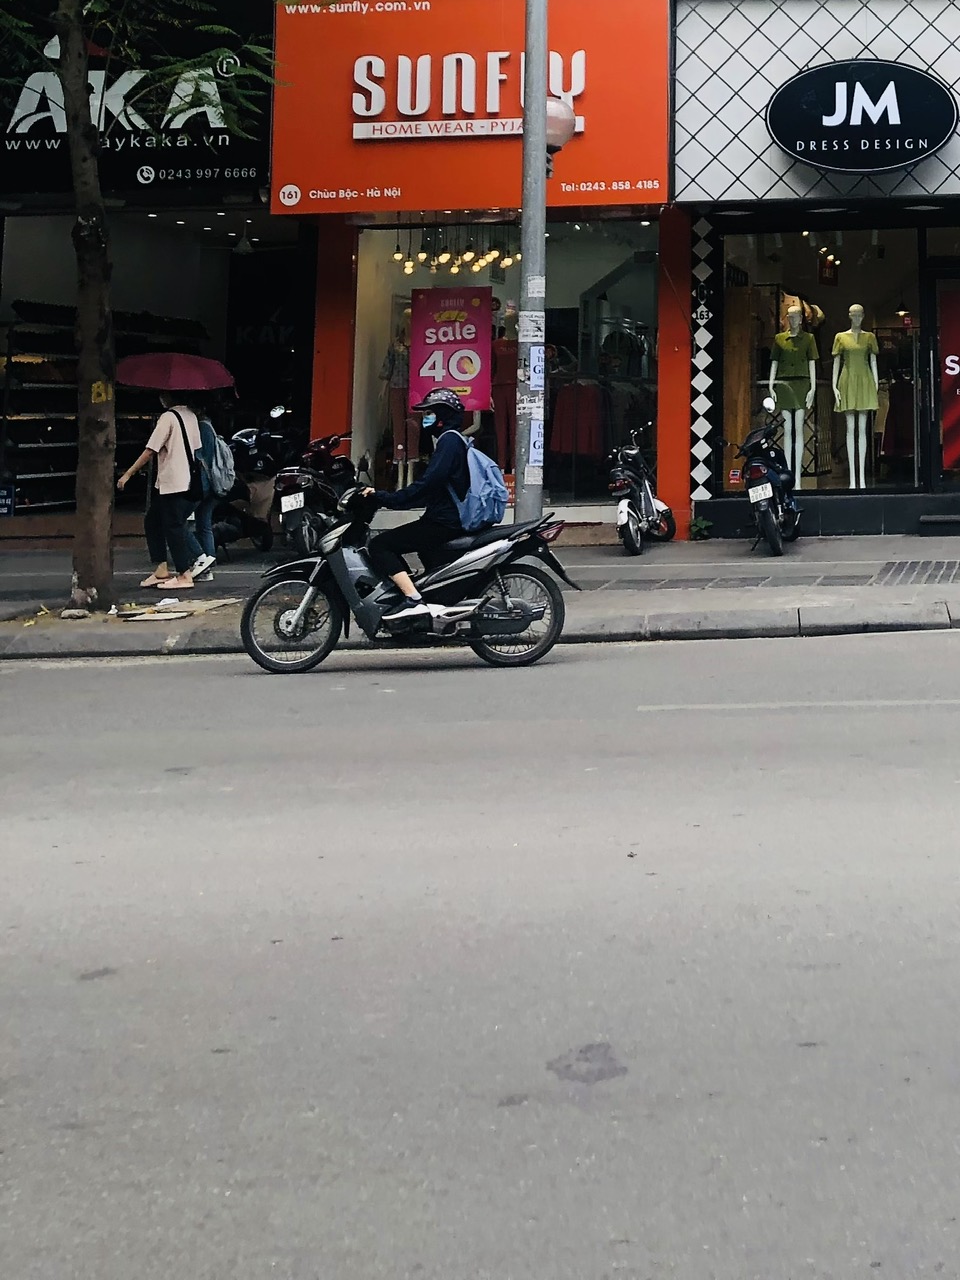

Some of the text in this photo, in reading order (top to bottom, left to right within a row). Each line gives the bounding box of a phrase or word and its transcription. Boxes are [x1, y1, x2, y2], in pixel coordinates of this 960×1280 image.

[285, 0, 431, 15] www.sunfly.com.vn
[822, 80, 901, 127] JM
[372, 123, 422, 136] HOME
[429, 121, 475, 134] WEAR
[796, 138, 928, 151] DRESS DESIGN
[159, 167, 257, 180] 0243 997 6666
[281, 190, 298, 200] 161
[367, 186, 380, 198] Hà
[384, 186, 401, 199] Nội
[425, 322, 476, 344] sale
[419, 349, 481, 382] 40
